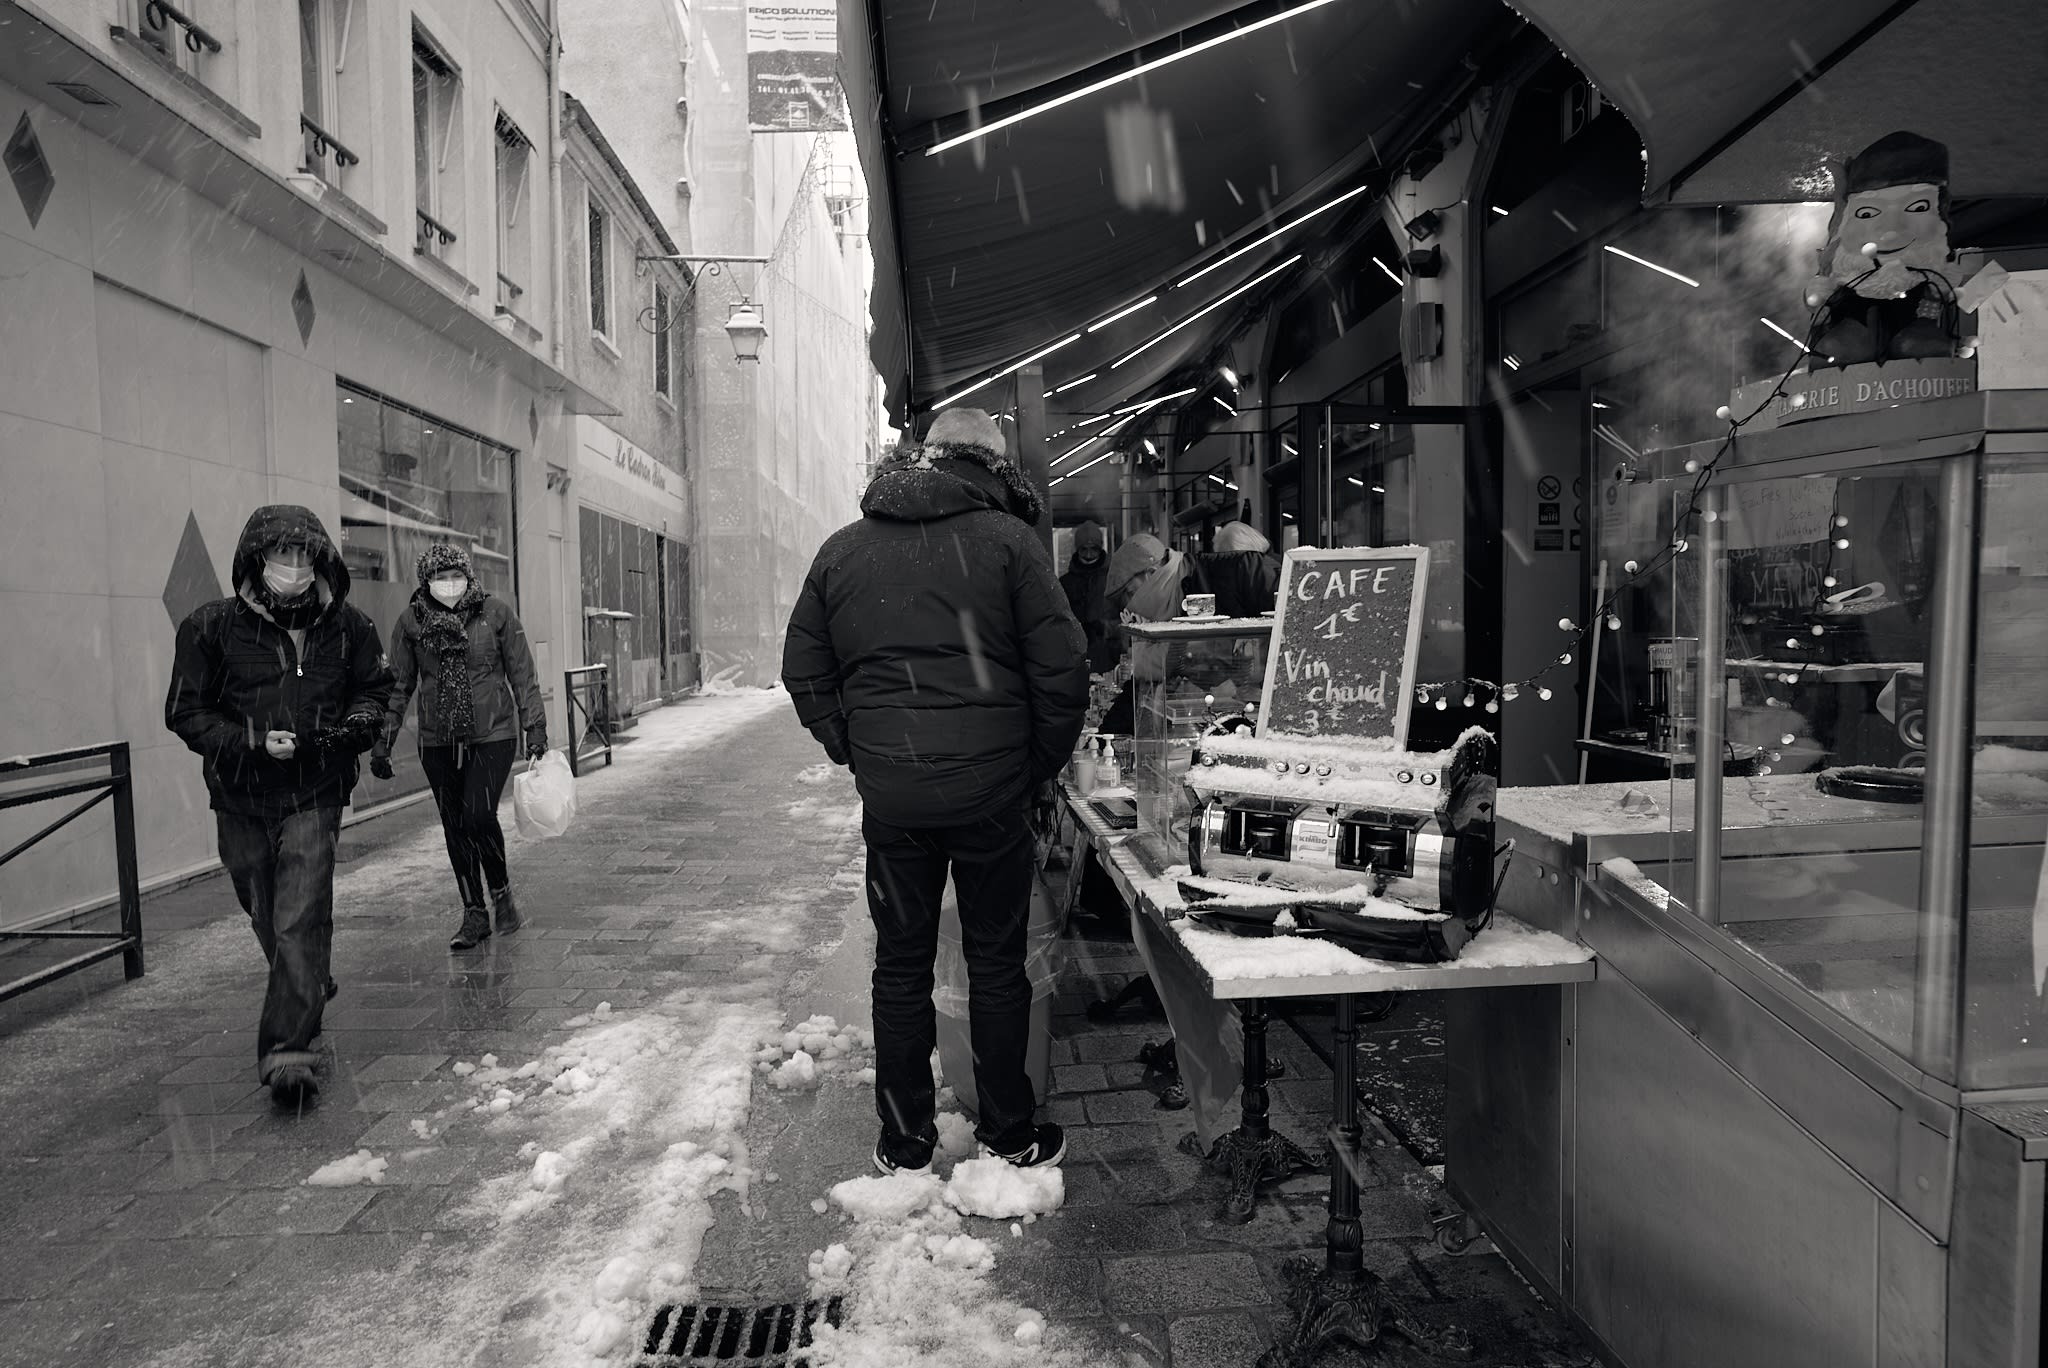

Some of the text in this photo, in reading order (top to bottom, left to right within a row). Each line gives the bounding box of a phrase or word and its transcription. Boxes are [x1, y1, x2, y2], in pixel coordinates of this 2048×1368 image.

[780, 7, 837, 16] SOLUTION
[1297, 566, 1397, 601] CAFE
[1313, 602, 1363, 640] 1€
[1284, 648, 1331, 684] Vin
[1307, 670, 1387, 705] chaud
